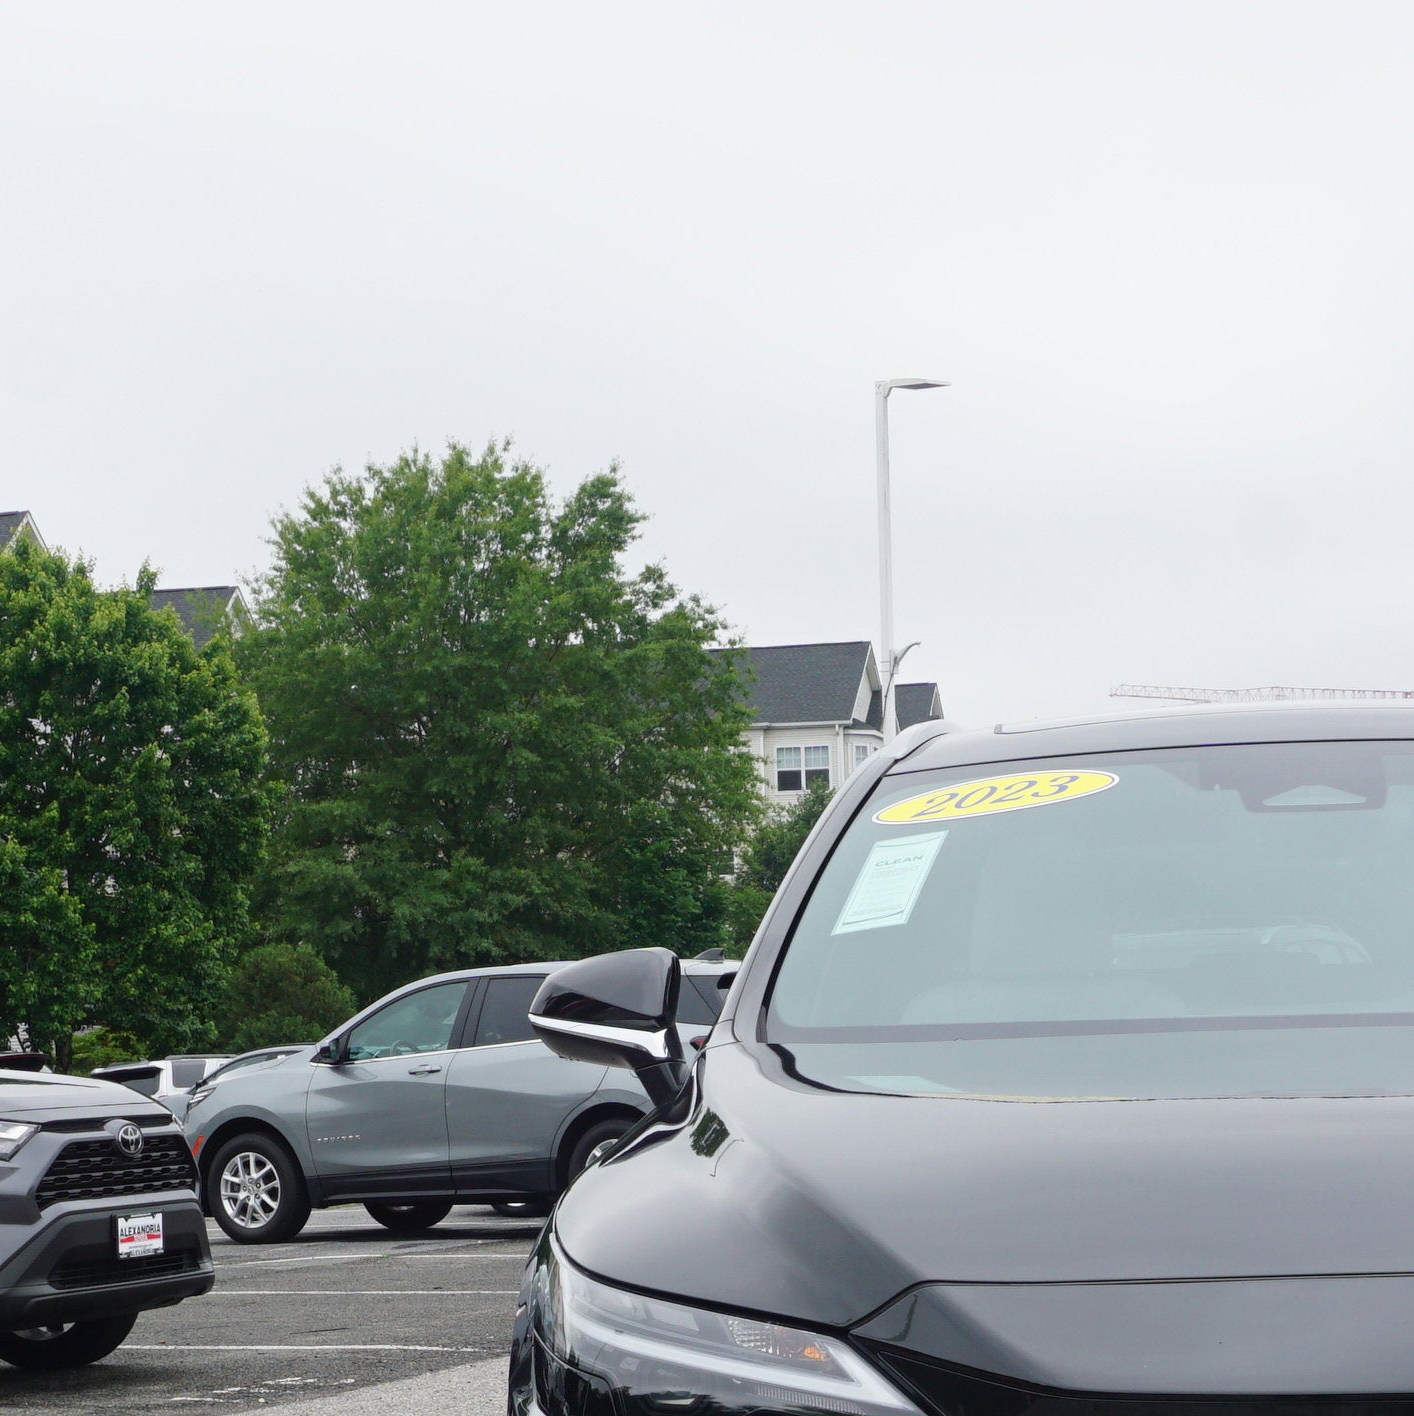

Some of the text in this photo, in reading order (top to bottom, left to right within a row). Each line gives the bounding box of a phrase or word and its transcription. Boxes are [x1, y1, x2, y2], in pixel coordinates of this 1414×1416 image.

[910, 775, 1080, 818] 2023
[874, 853, 924, 867] CLEAN
[120, 1223, 161, 1237] ALEXANDRIA
